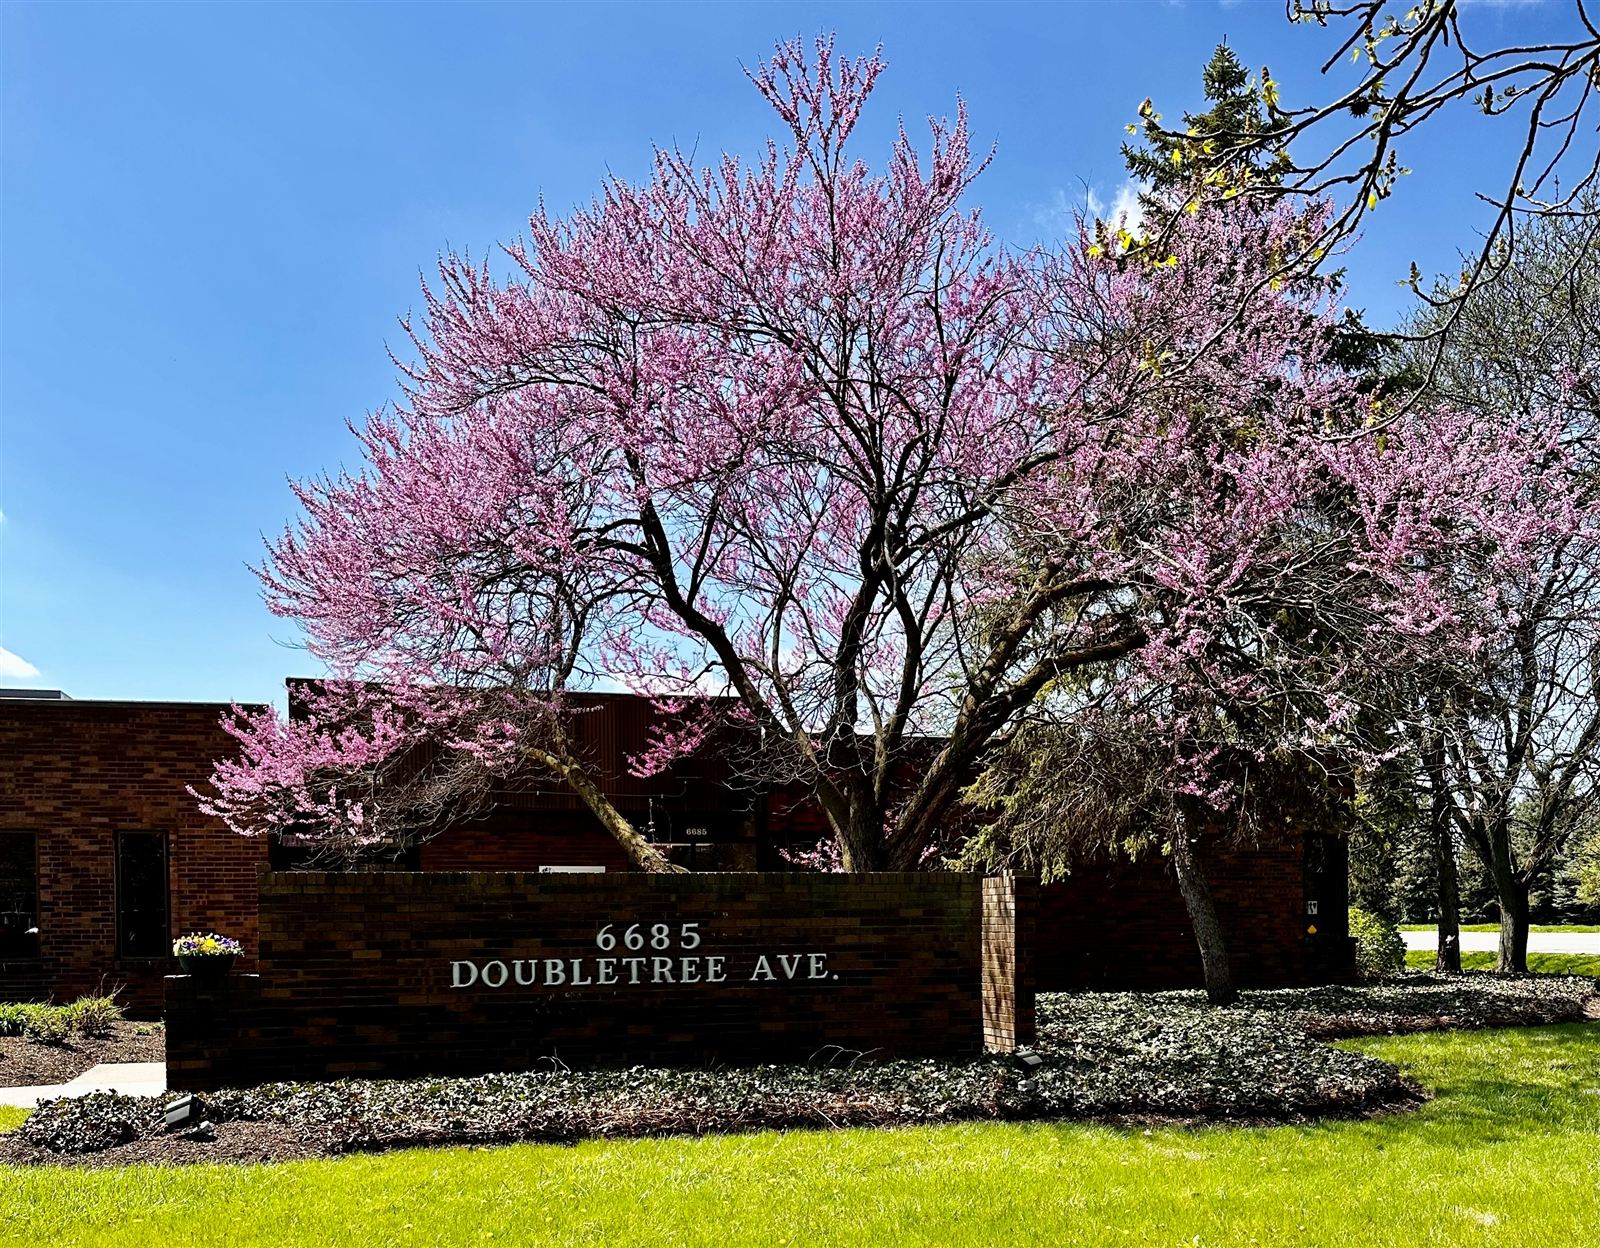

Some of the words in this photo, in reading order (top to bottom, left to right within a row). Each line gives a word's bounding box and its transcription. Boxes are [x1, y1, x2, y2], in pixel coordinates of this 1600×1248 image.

[686, 828, 707, 836] 6685
[596, 923, 701, 951] 6685
[449, 956, 727, 988] DOUBLETREE
[750, 953, 839, 981] AVE.
